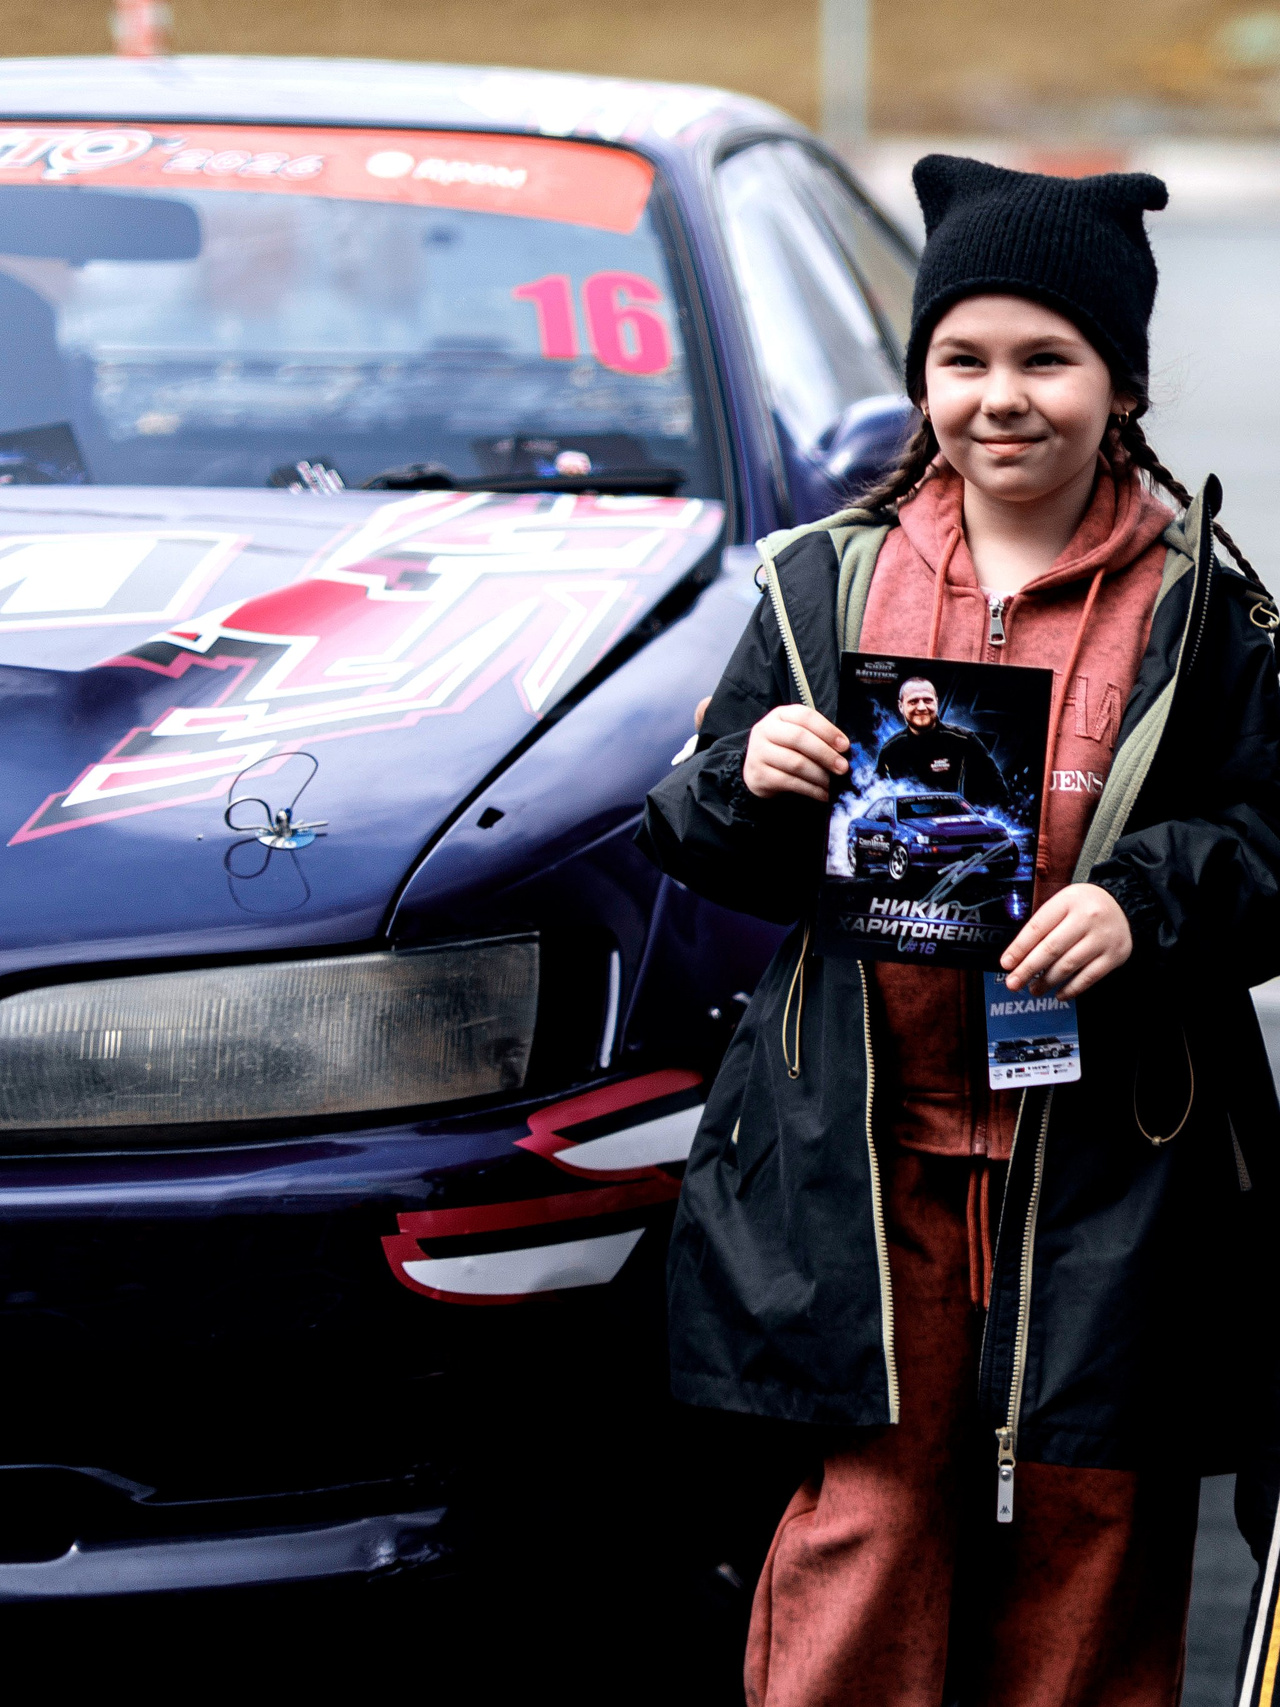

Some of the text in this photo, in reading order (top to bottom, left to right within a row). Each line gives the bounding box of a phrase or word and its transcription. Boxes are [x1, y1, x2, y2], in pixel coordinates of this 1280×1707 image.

[512, 271, 673, 375] 16
[869, 897, 982, 924] НИКИТА
[990, 998, 1071, 1017] МЕХАНИК
